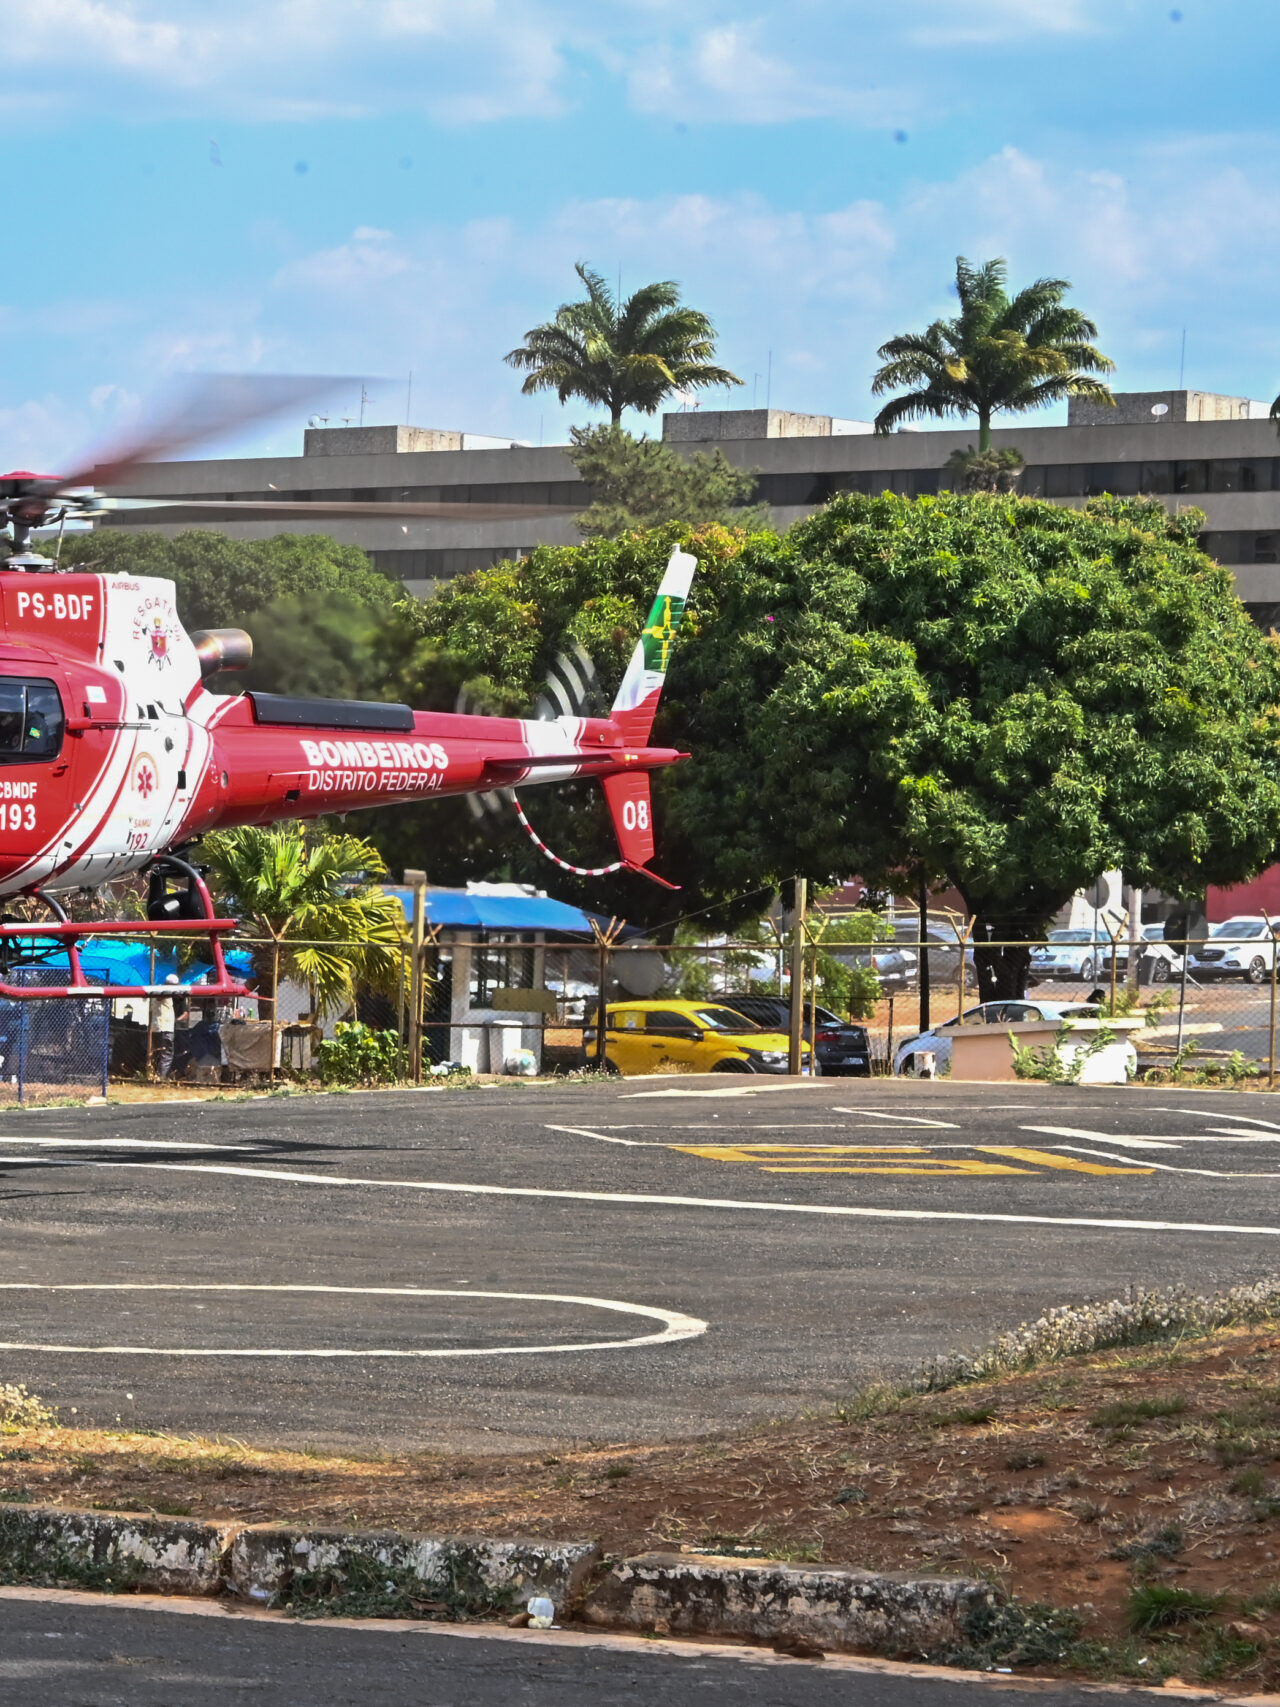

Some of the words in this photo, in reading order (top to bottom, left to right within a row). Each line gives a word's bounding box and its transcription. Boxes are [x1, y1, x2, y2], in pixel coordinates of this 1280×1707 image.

[111, 582, 140, 591] AIRBUS
[17, 592, 94, 620] PS-BDF
[300, 740, 449, 769] BOMBEIROS
[308, 770, 377, 791] DISTRITO
[378, 772, 444, 791] FEDERAL
[623, 800, 649, 831] 08
[128, 832, 148, 851] 192
